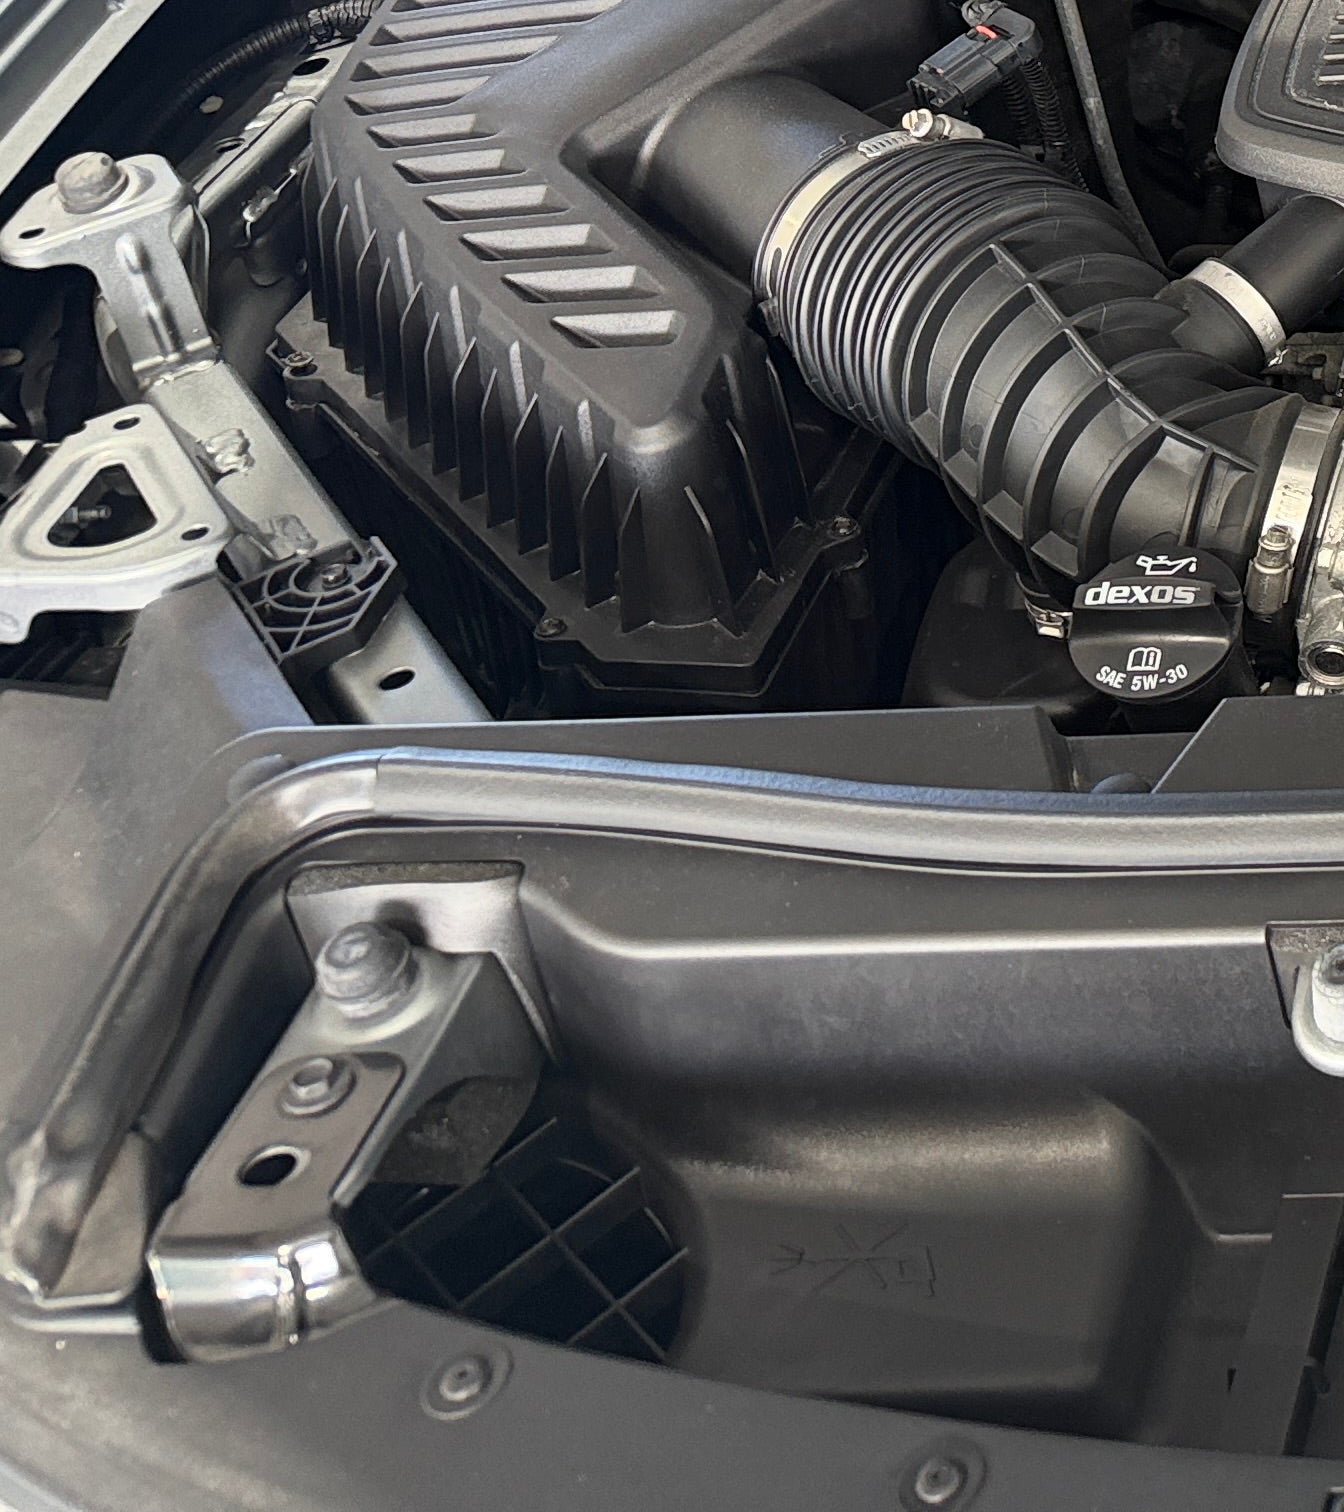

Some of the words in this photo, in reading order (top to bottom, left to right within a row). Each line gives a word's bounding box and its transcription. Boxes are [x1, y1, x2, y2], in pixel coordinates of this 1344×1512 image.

[1084, 581, 1197, 606] dexos
[1095, 665, 1127, 689] SAE
[1130, 663, 1188, 692] 5W-30
